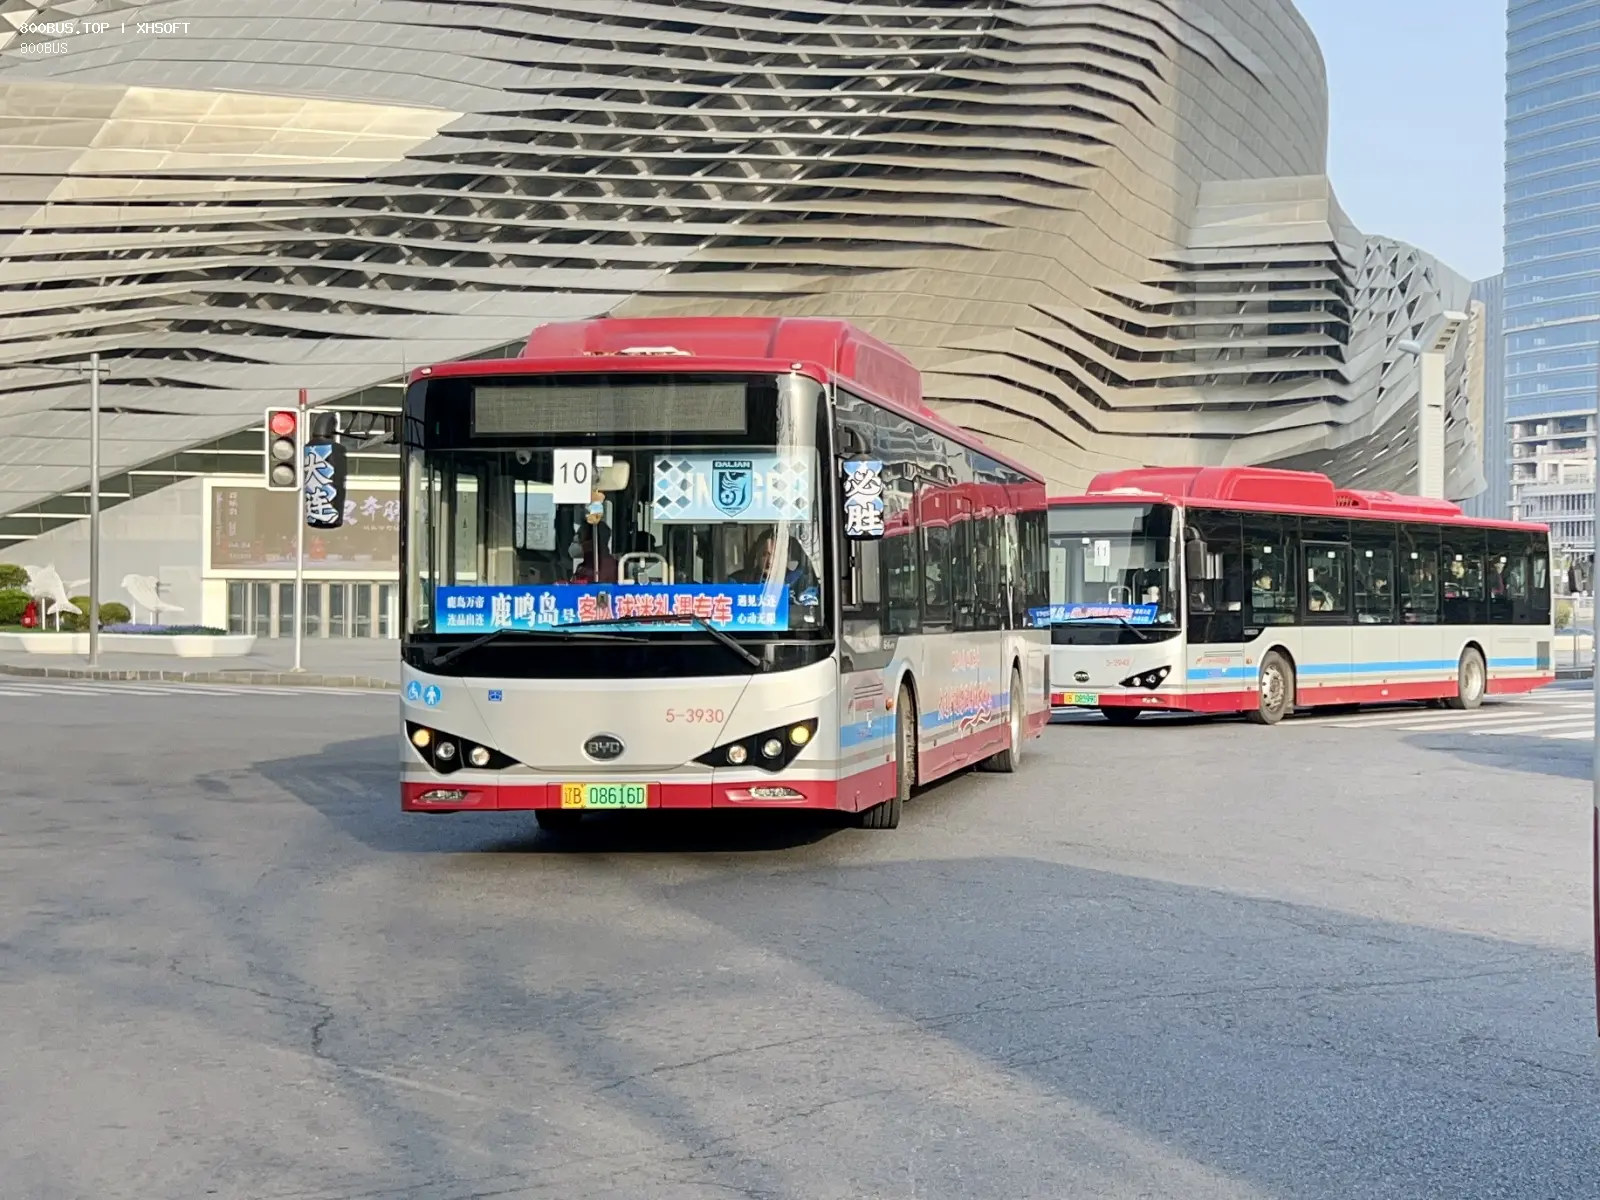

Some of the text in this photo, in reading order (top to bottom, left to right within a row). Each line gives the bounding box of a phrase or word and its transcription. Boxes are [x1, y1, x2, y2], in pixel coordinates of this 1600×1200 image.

[560, 462, 587, 485] 10
[304, 452, 338, 523] 大连
[844, 469, 884, 535] 必胜
[665, 708, 724, 723] 5-3930
[588, 741, 620, 753] BYD
[590, 787, 645, 804] 08616D
